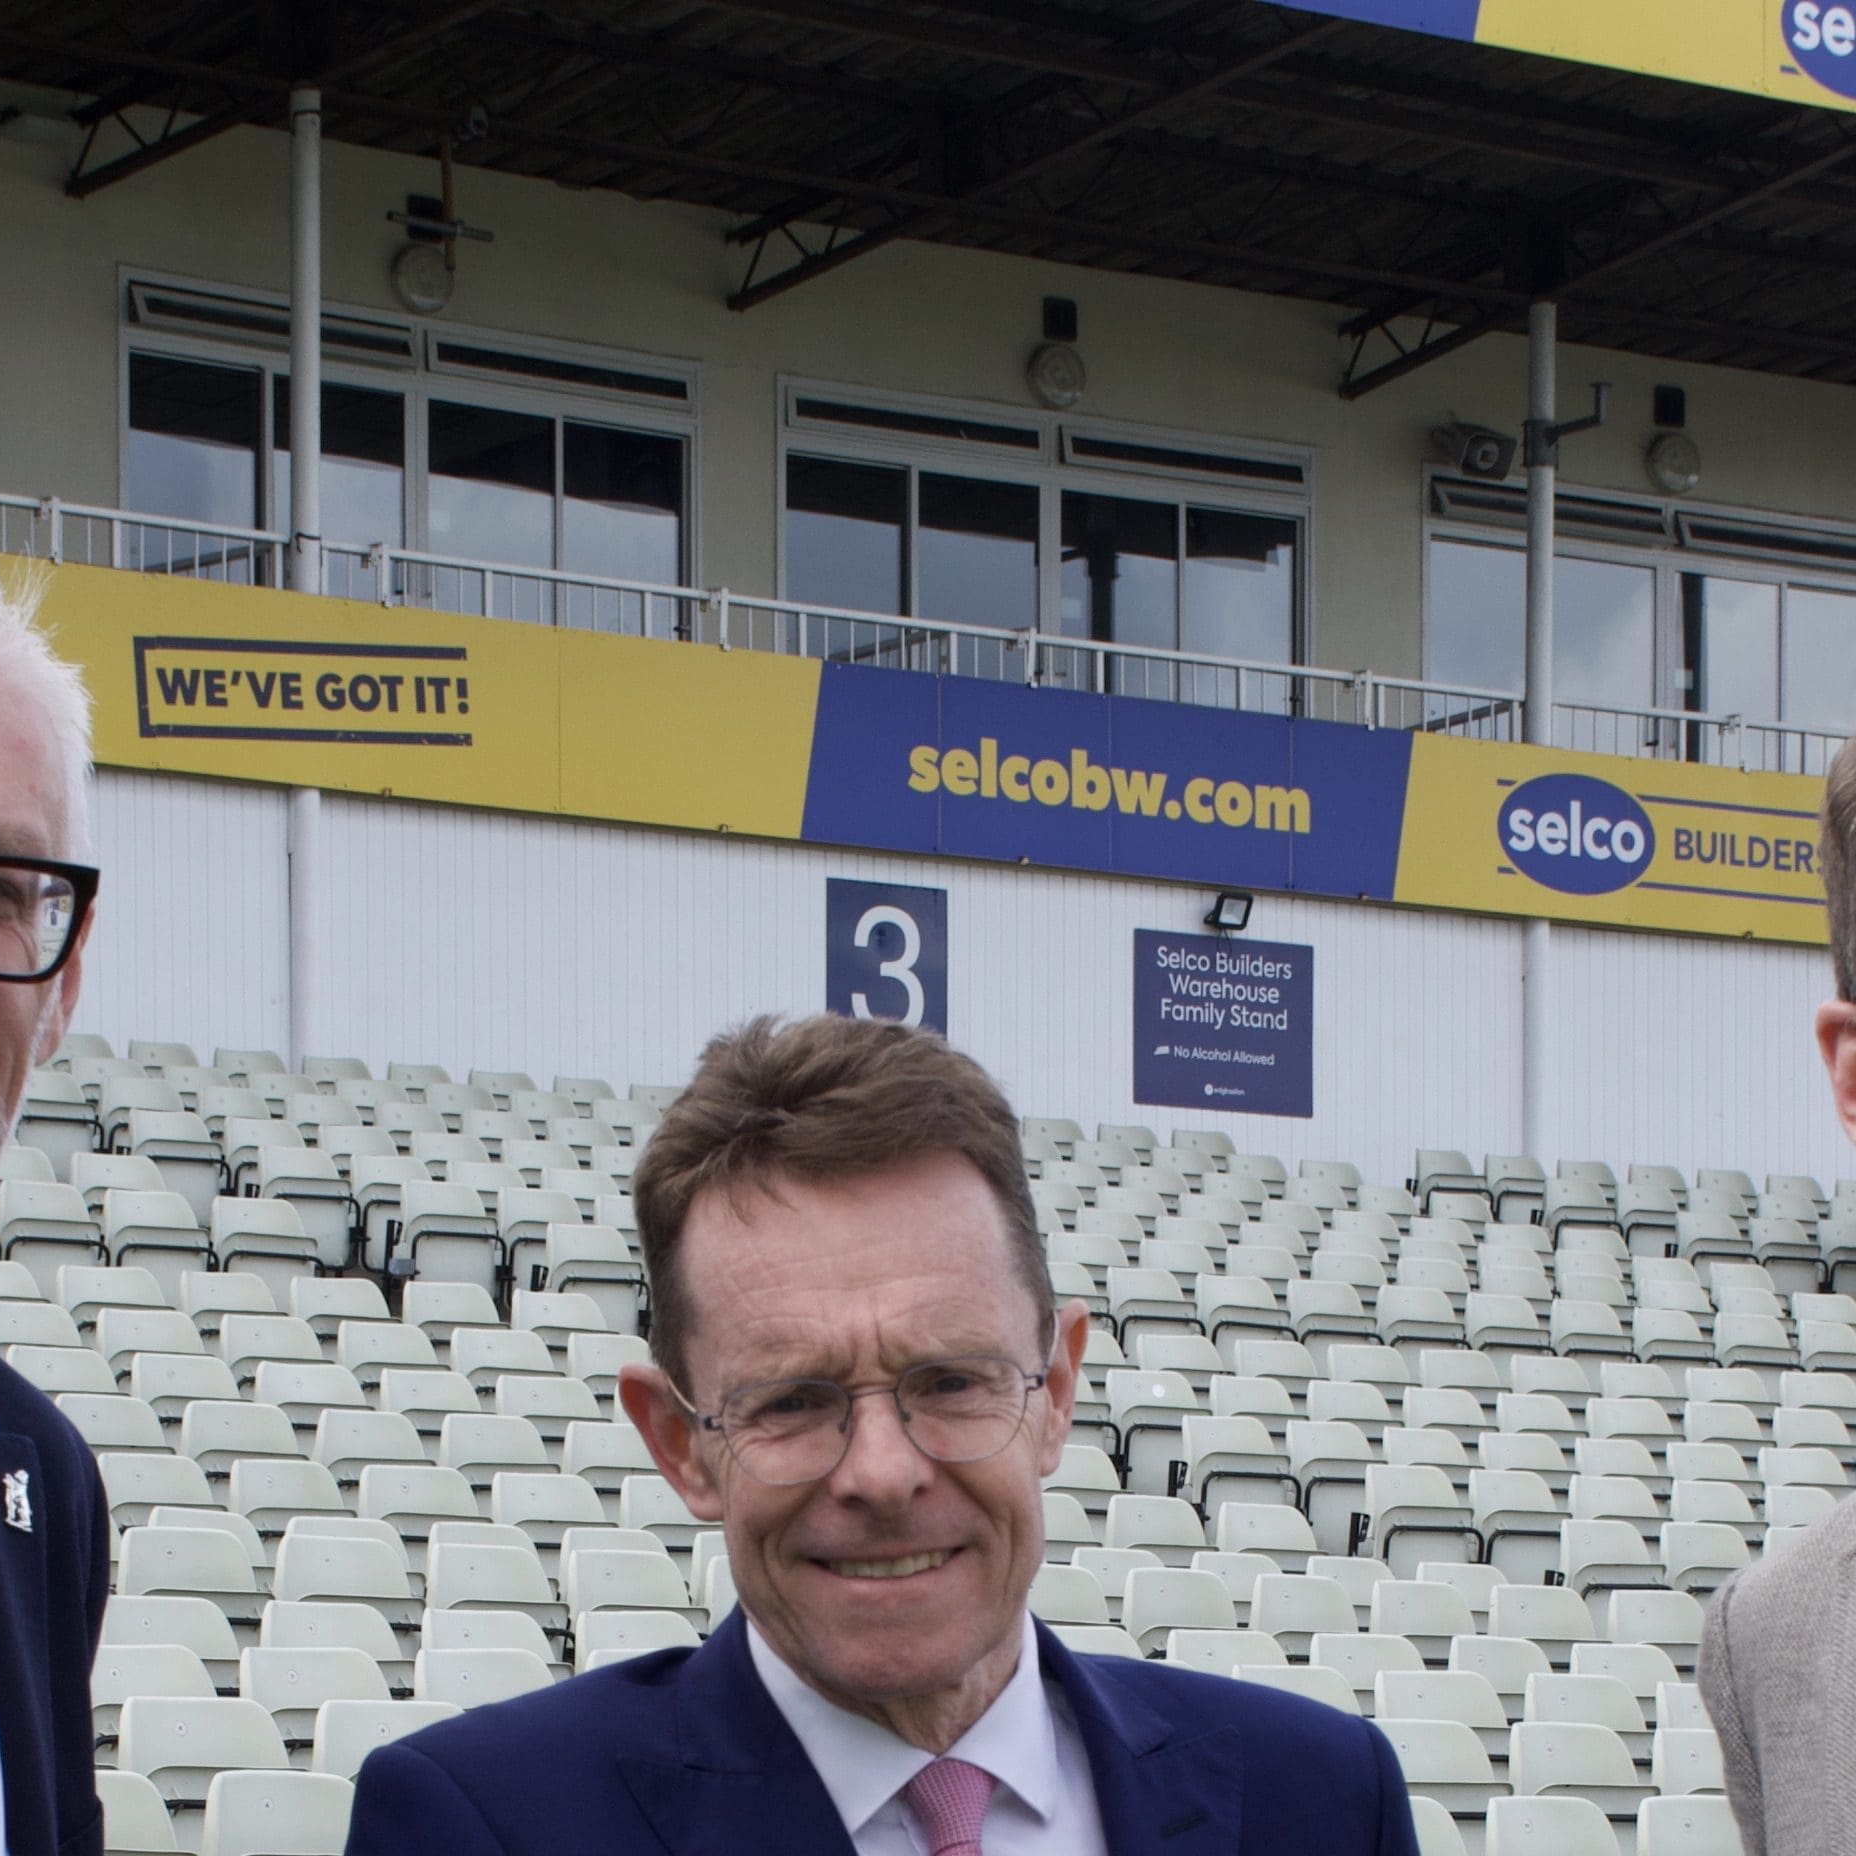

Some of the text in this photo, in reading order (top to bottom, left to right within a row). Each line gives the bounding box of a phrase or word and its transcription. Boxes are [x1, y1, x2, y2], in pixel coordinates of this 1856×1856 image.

[156, 667, 470, 714] WE'VE GOT IT!
[908, 737, 1311, 833] selcobw.com
[1508, 801, 1644, 863] selco
[1674, 828, 1823, 874] BUILDER
[851, 905, 924, 1027] 3
[1157, 946, 1292, 980] Selco Builders
[1169, 973, 1280, 1004] Warehouse
[1161, 998, 1287, 1030] Family Stand
[1174, 1046, 1275, 1066] No Alcohol Allowed
